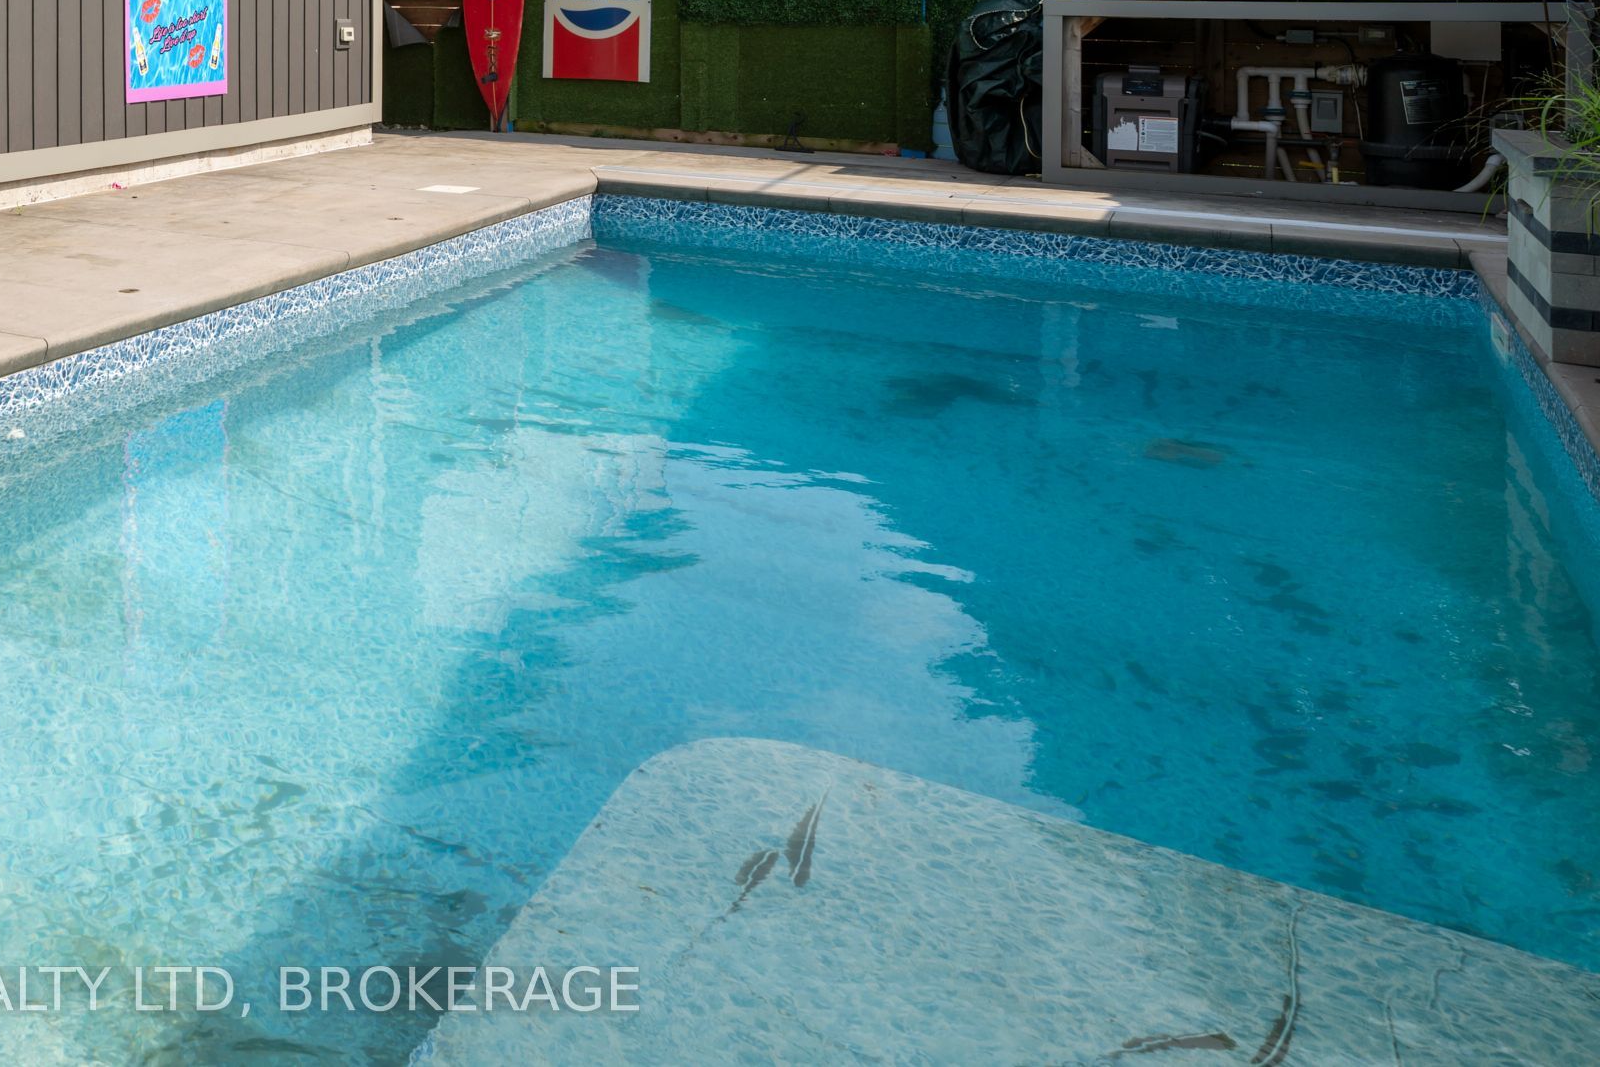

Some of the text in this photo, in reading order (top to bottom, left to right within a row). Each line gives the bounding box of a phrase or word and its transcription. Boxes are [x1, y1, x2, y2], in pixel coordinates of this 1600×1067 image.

[149, 5, 208, 44] Life is too short
[160, 28, 197, 54] Live it up
